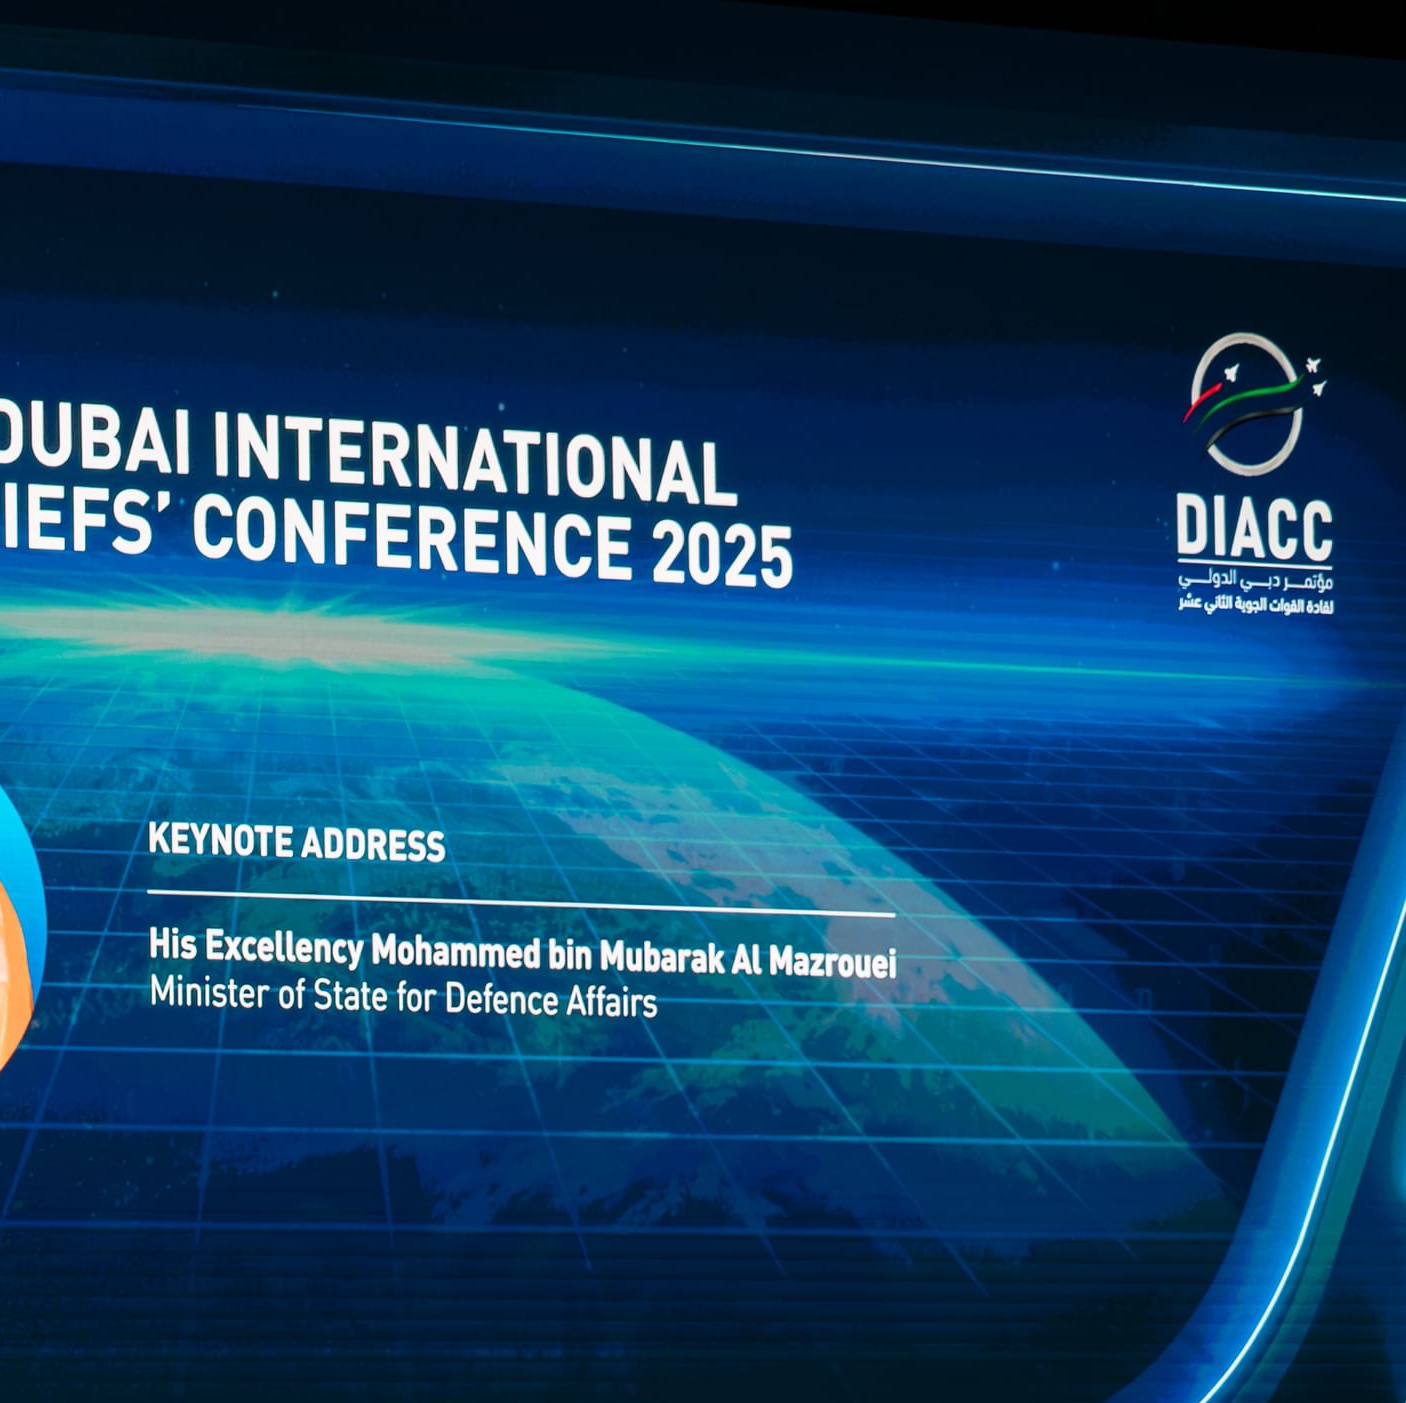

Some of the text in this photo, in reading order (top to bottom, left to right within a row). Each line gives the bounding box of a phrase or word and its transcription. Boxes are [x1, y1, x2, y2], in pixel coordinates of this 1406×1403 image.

[215, 410, 738, 506] INTERNATIONAL
[193, 492, 632, 582] CONFERENCE
[651, 518, 794, 590] 2025
[1176, 492, 1333, 562] DIACC
[1178, 567, 1334, 594] مؤتمر دبي الدولي
[1178, 592, 1335, 616] لقادة القوات الجوية الثاني عشر
[149, 821, 447, 864] KEYNOTE ADDRESS
[149, 926, 898, 980] His Excellency Mohammed bin Mubarak Al Mazrouei
[150, 973, 659, 1020] Minister of State for Defence Affairs
